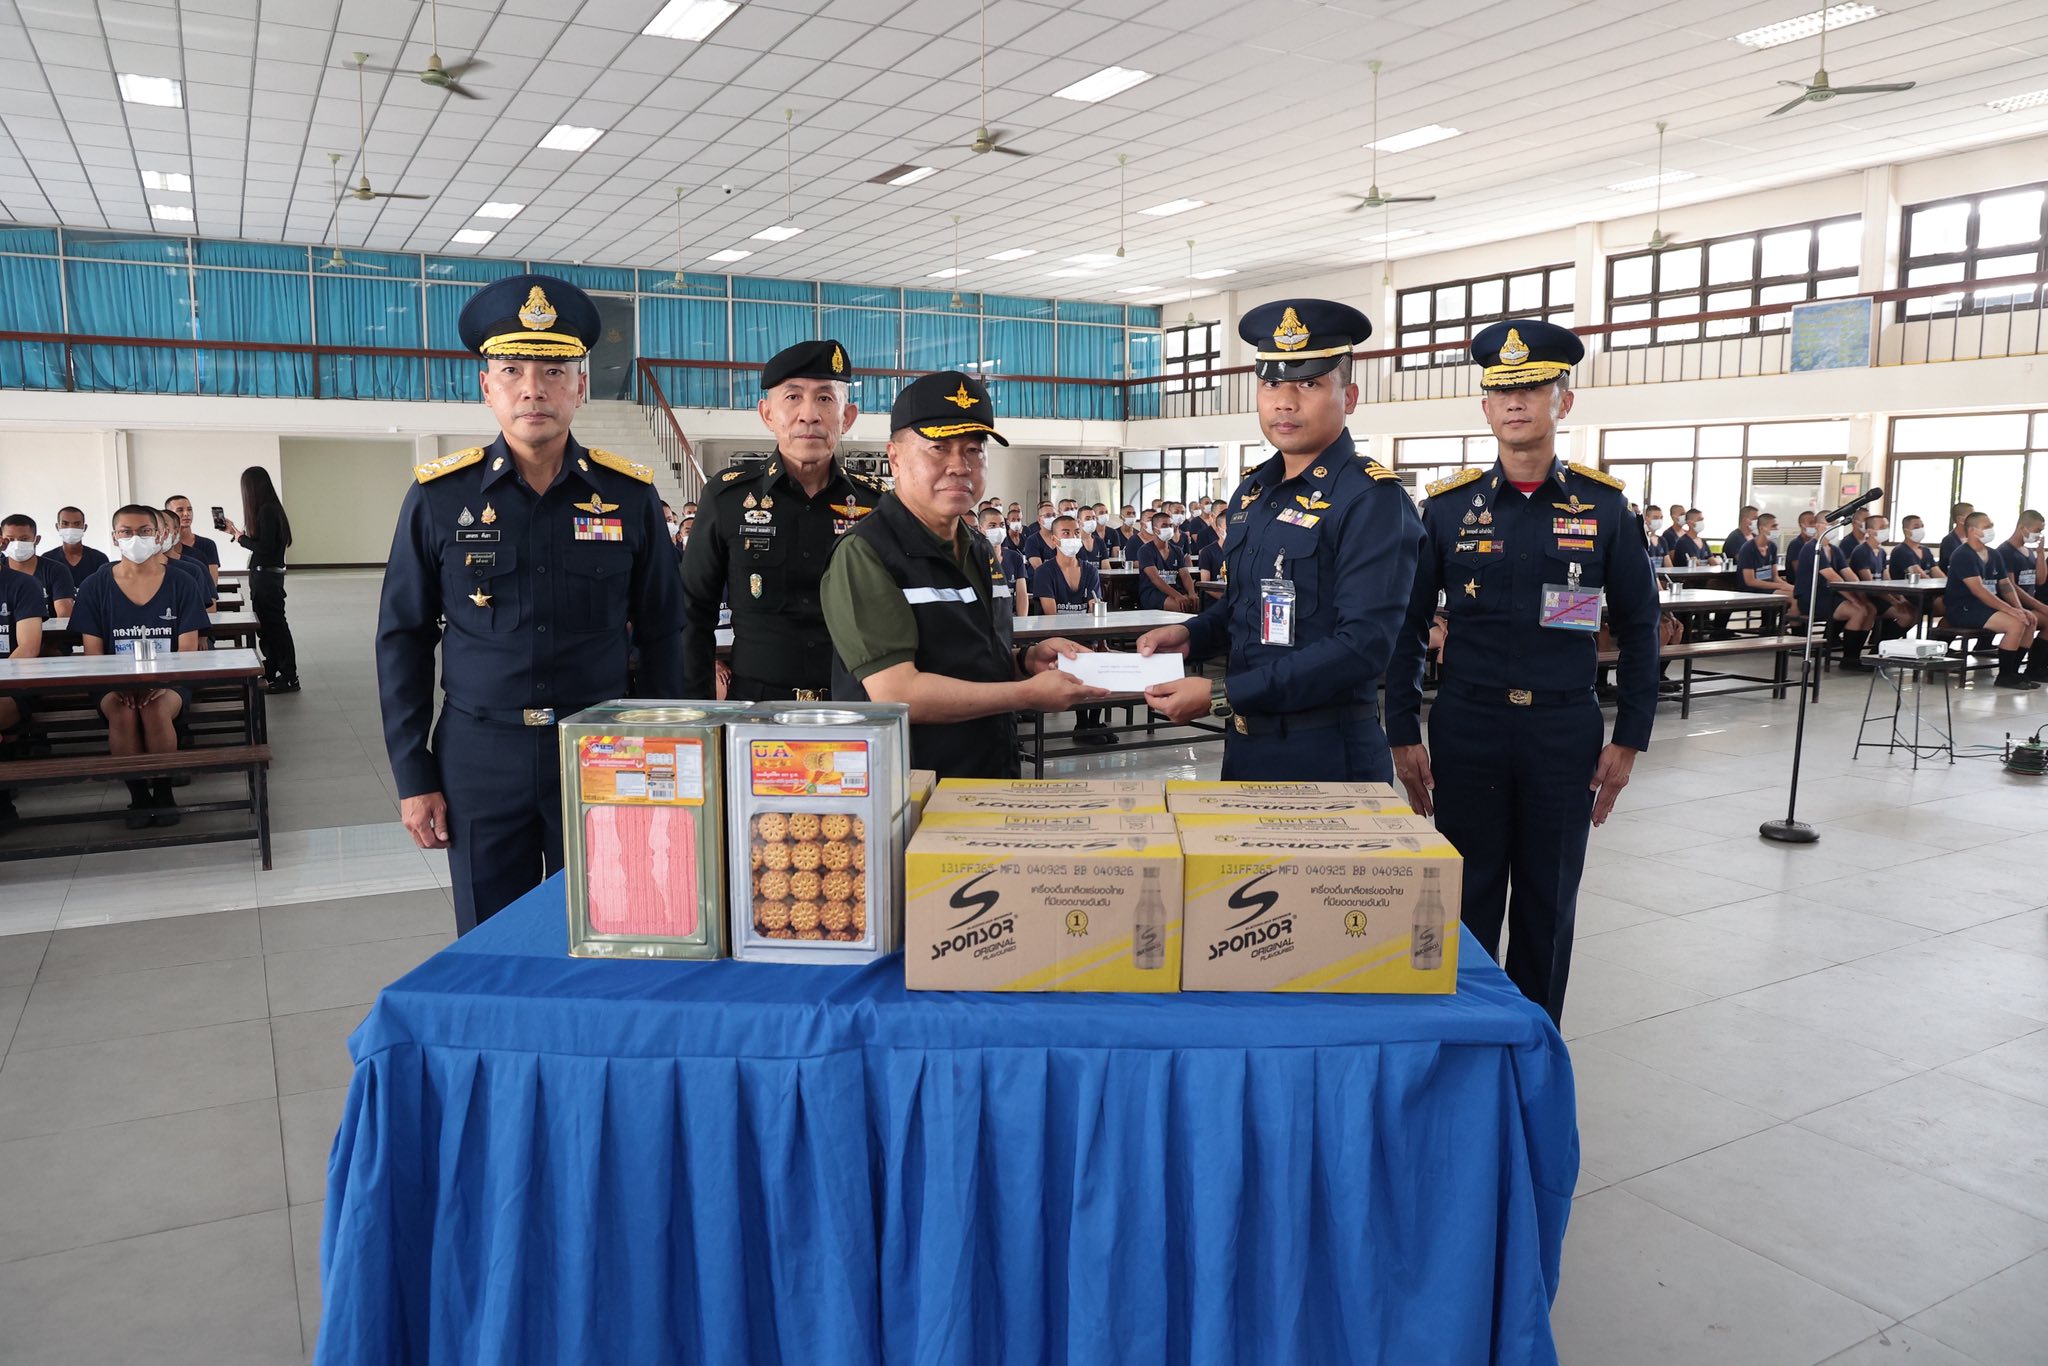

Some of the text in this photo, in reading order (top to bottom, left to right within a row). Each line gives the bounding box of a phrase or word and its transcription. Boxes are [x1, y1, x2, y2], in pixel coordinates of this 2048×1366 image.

[1000, 864, 1020, 874] MFD
[1027, 865, 1067, 875] 040925
[1074, 865, 1087, 875] BB
[1093, 866, 1134, 876] 040926
[1221, 864, 1413, 877] 131FF365 MFD 040925 BB 040926
[1073, 915, 1080, 926] 1
[1351, 915, 1358, 927] 1
[931, 919, 1014, 960] SPONSOR
[1208, 919, 1292, 960] SPONSOR
[973, 938, 1016, 958] ORIGINAL
[982, 945, 1016, 960] FLAVOURED
[1250, 938, 1294, 958] ORIGINAL
[1260, 945, 1294, 961] FLAVOURED
